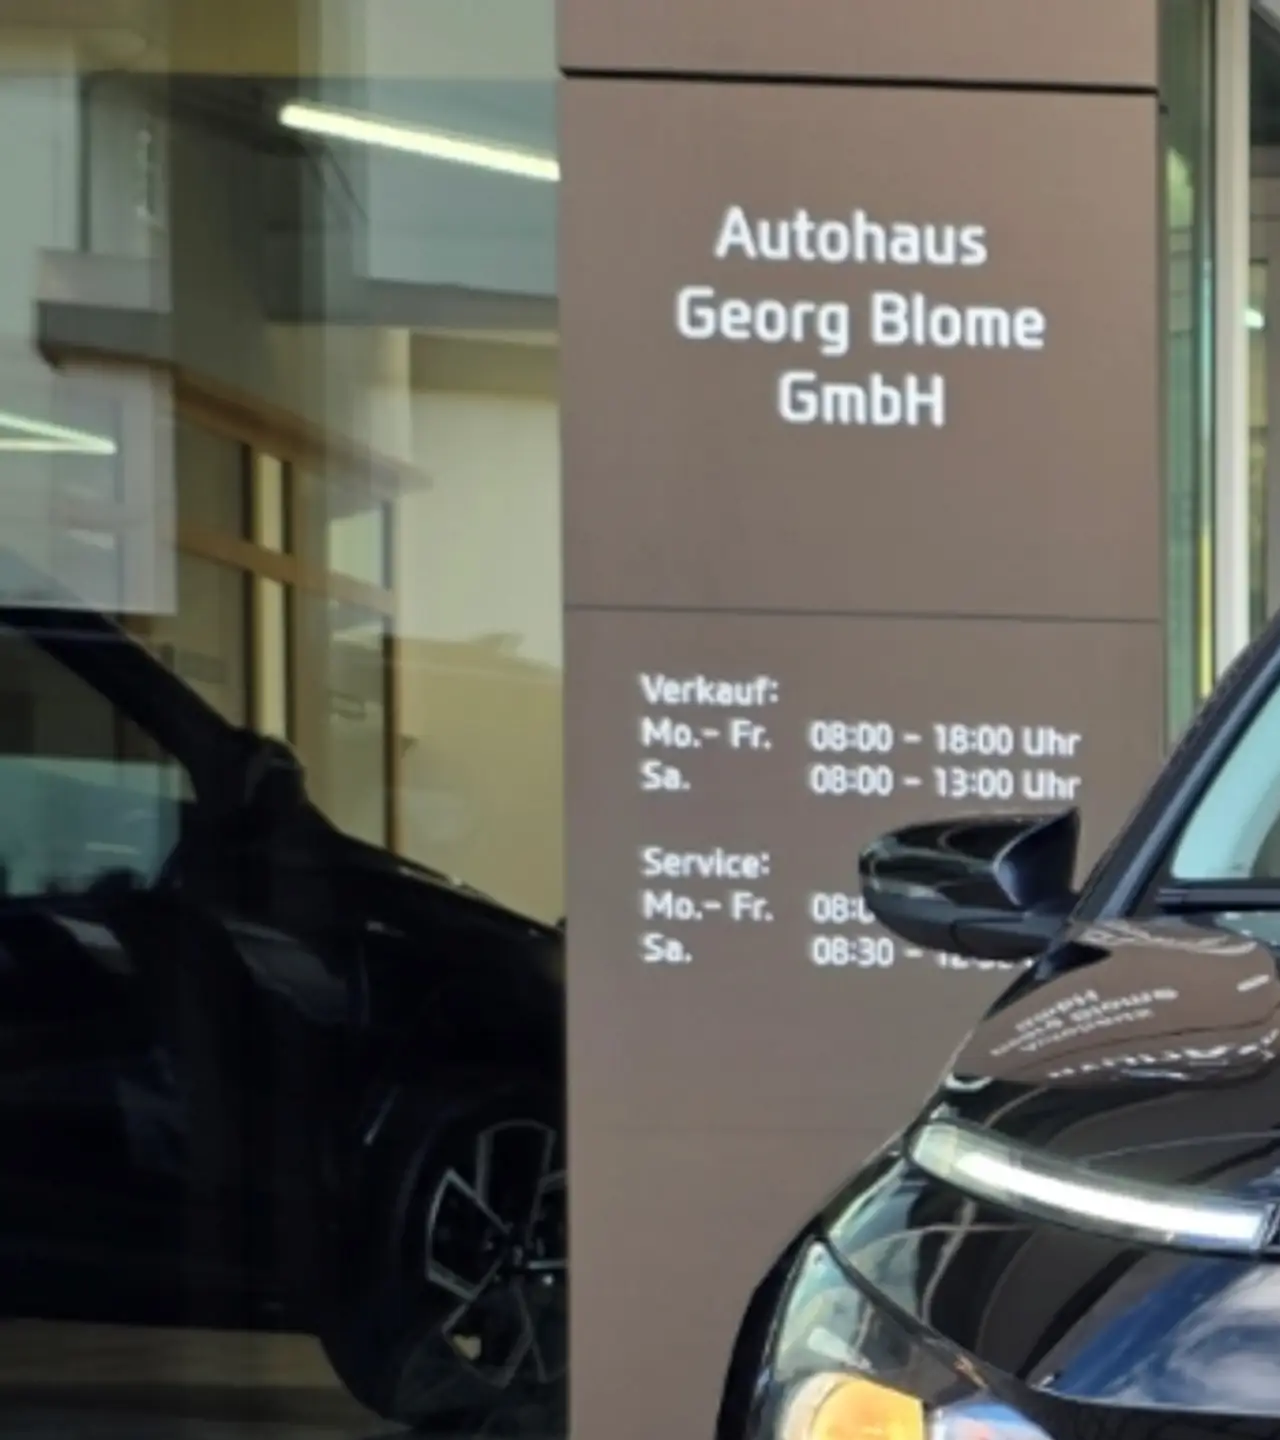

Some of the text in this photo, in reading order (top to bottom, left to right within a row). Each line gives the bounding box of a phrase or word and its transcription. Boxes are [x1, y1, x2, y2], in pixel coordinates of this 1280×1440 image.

[714, 205, 988, 267] Autohaus
[675, 285, 1046, 357] Georg Blome
[777, 370, 945, 427] GmbH
[640, 673, 779, 706] Verkauf:
[729, 717, 773, 751] Fr.
[808, 720, 894, 753] 08:00
[933, 723, 1014, 757] 18:00
[1021, 724, 1082, 758] Uhr
[640, 758, 691, 791] Sa.
[808, 763, 894, 797] 08:00
[933, 767, 1014, 800] 13:00
[1021, 768, 1082, 801] Uhr
[641, 846, 771, 880] Service:
[730, 890, 774, 922] Fr.
[641, 931, 692, 964] Sa.
[810, 935, 895, 968] 08:30
